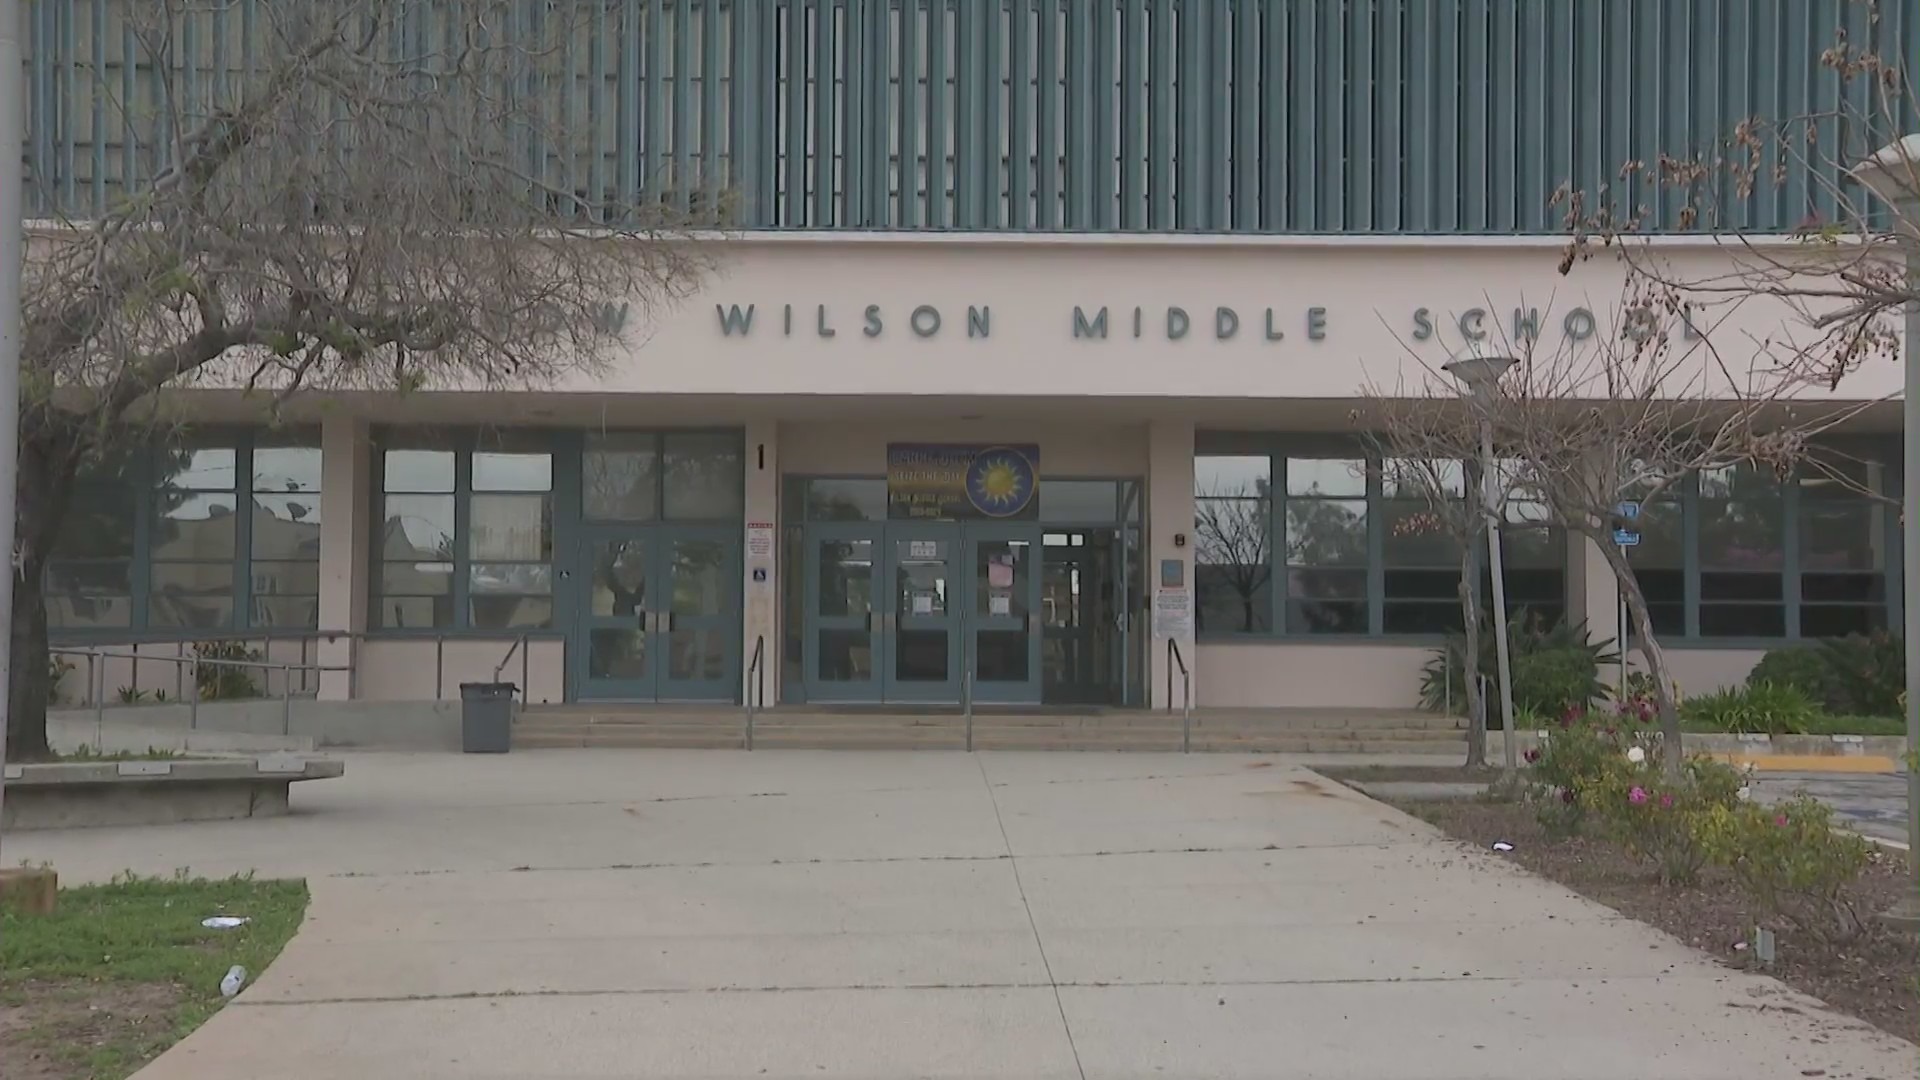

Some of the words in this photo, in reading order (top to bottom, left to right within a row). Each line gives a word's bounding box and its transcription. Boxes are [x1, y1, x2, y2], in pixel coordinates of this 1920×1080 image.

[715, 303, 990, 338] WILSON
[1072, 306, 1327, 342] MIDDLE
[1412, 307, 1701, 341] SCHOOL
